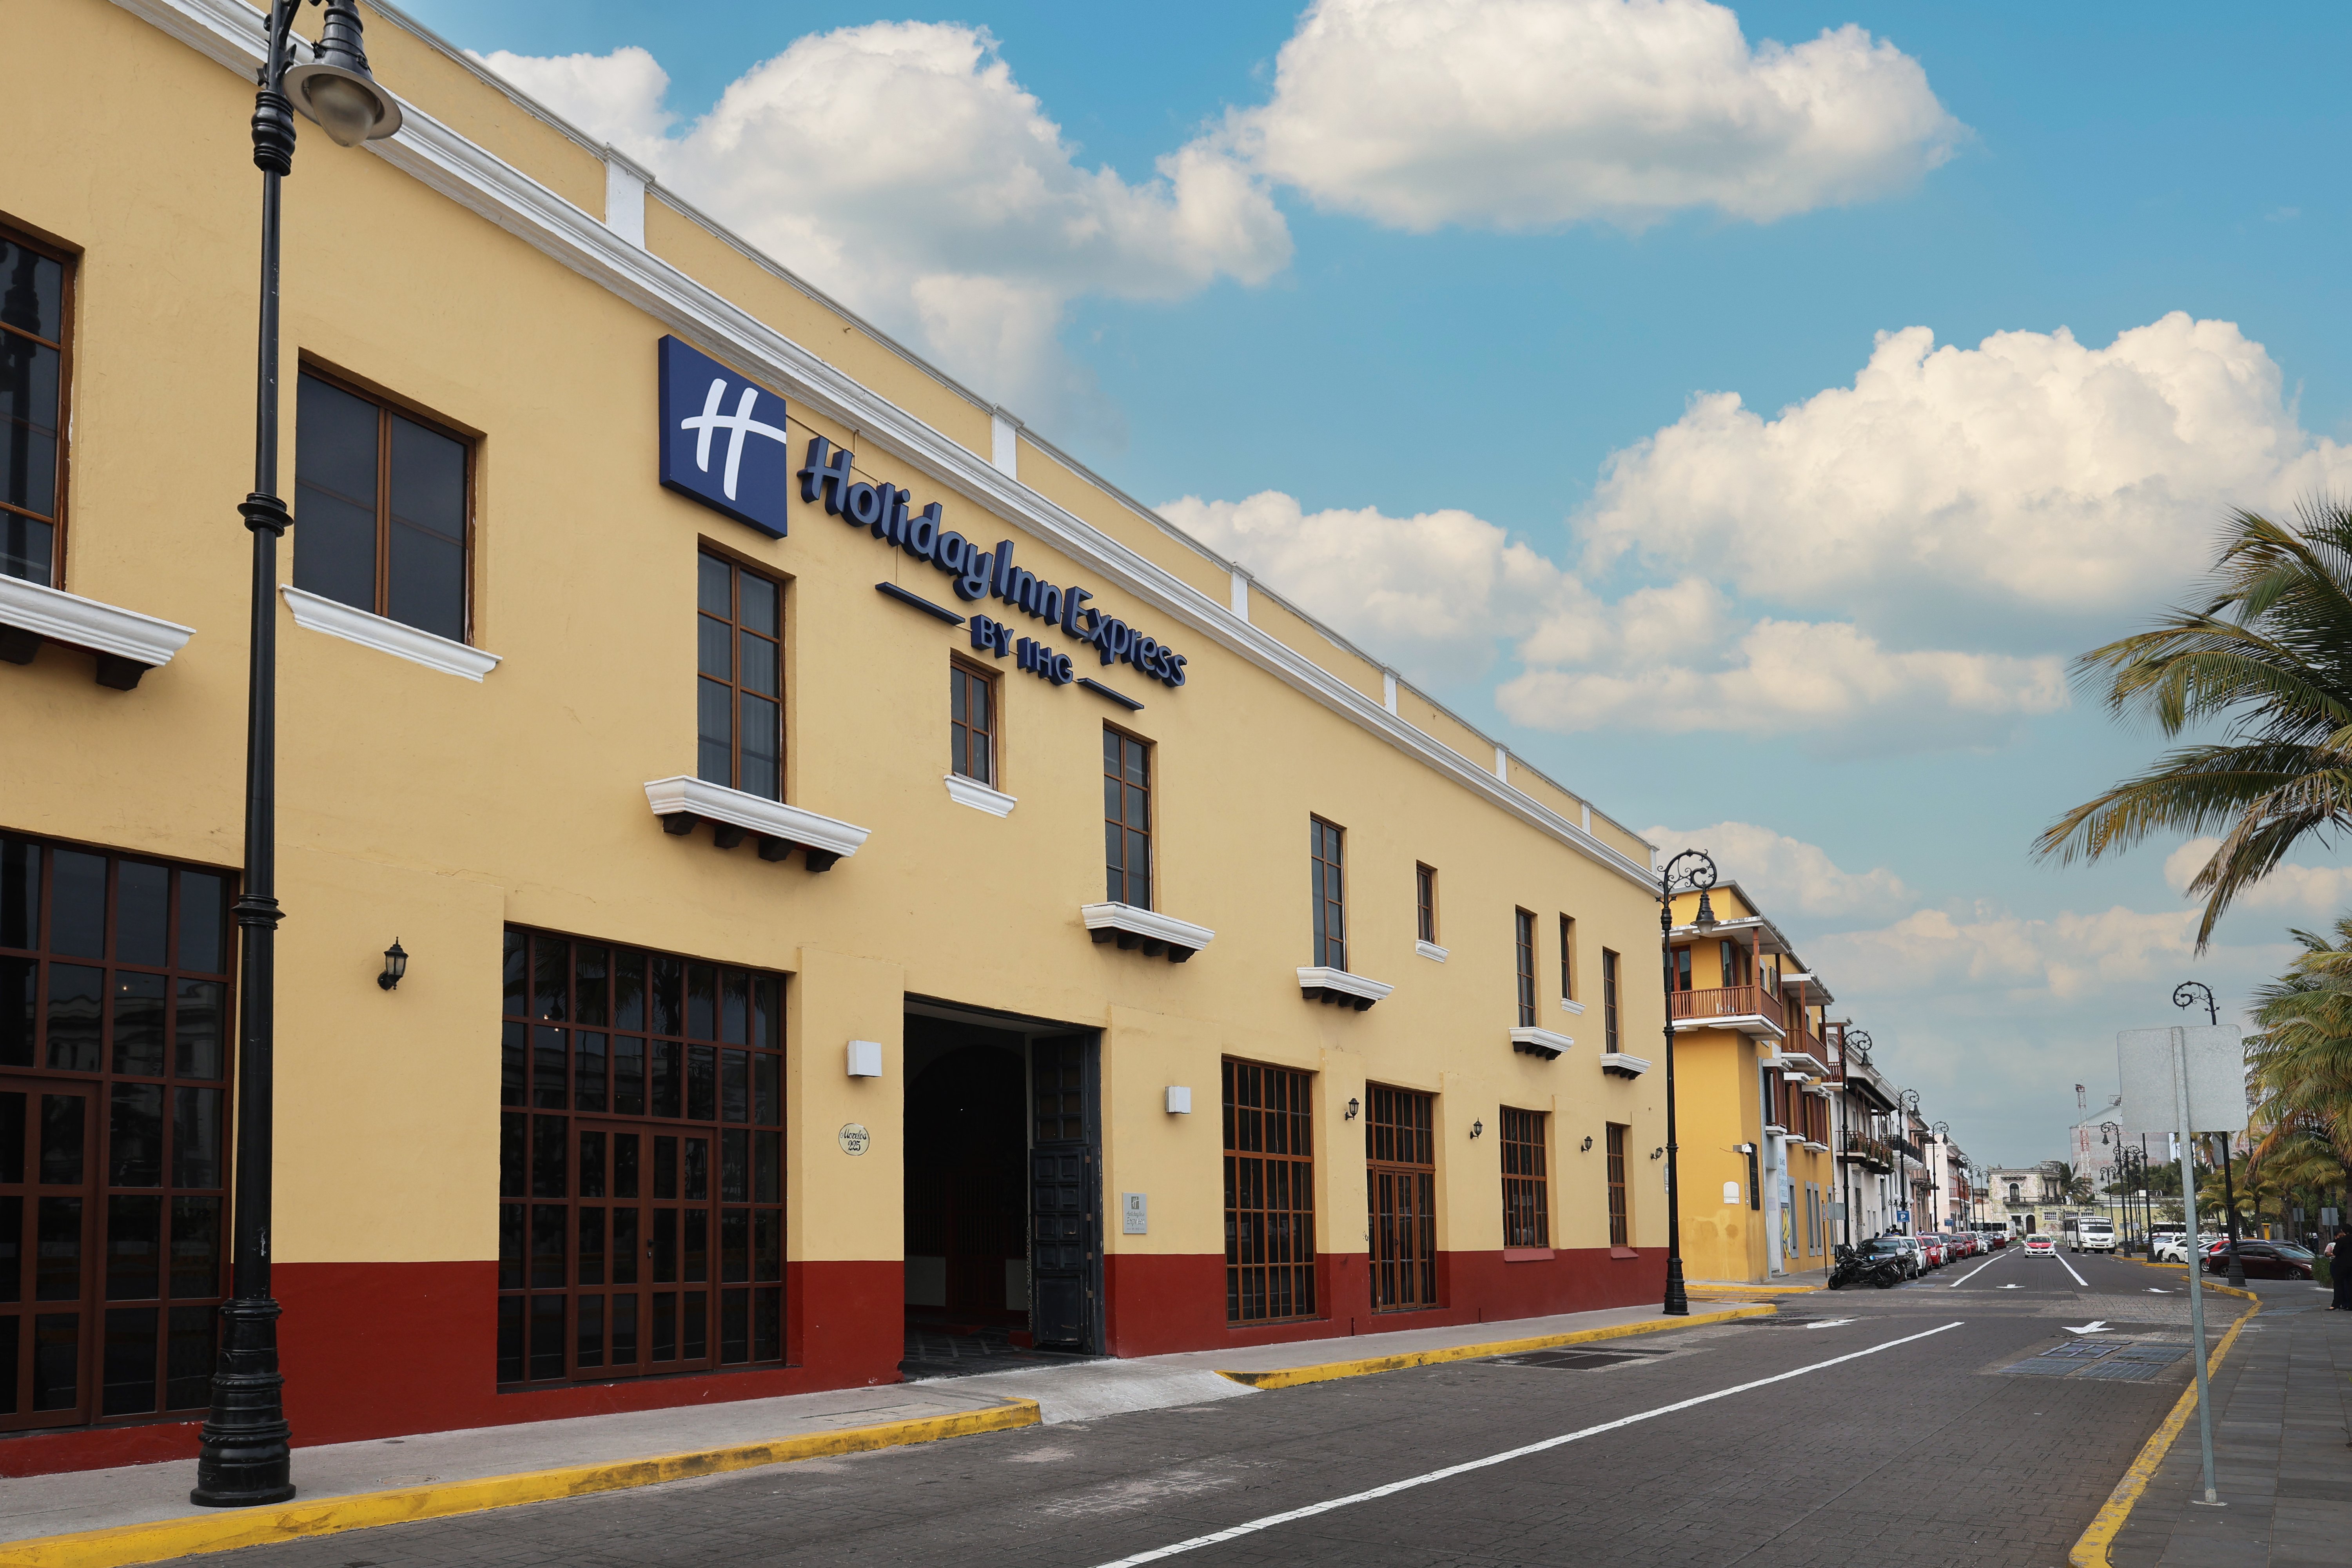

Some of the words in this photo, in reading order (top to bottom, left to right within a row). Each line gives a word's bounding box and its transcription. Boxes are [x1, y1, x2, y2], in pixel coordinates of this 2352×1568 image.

[971, 614, 1014, 659] BY
[1017, 637, 1073, 686] IHG
[840, 1129, 867, 1140] Morelos
[848, 1140, 860, 1151] 225
